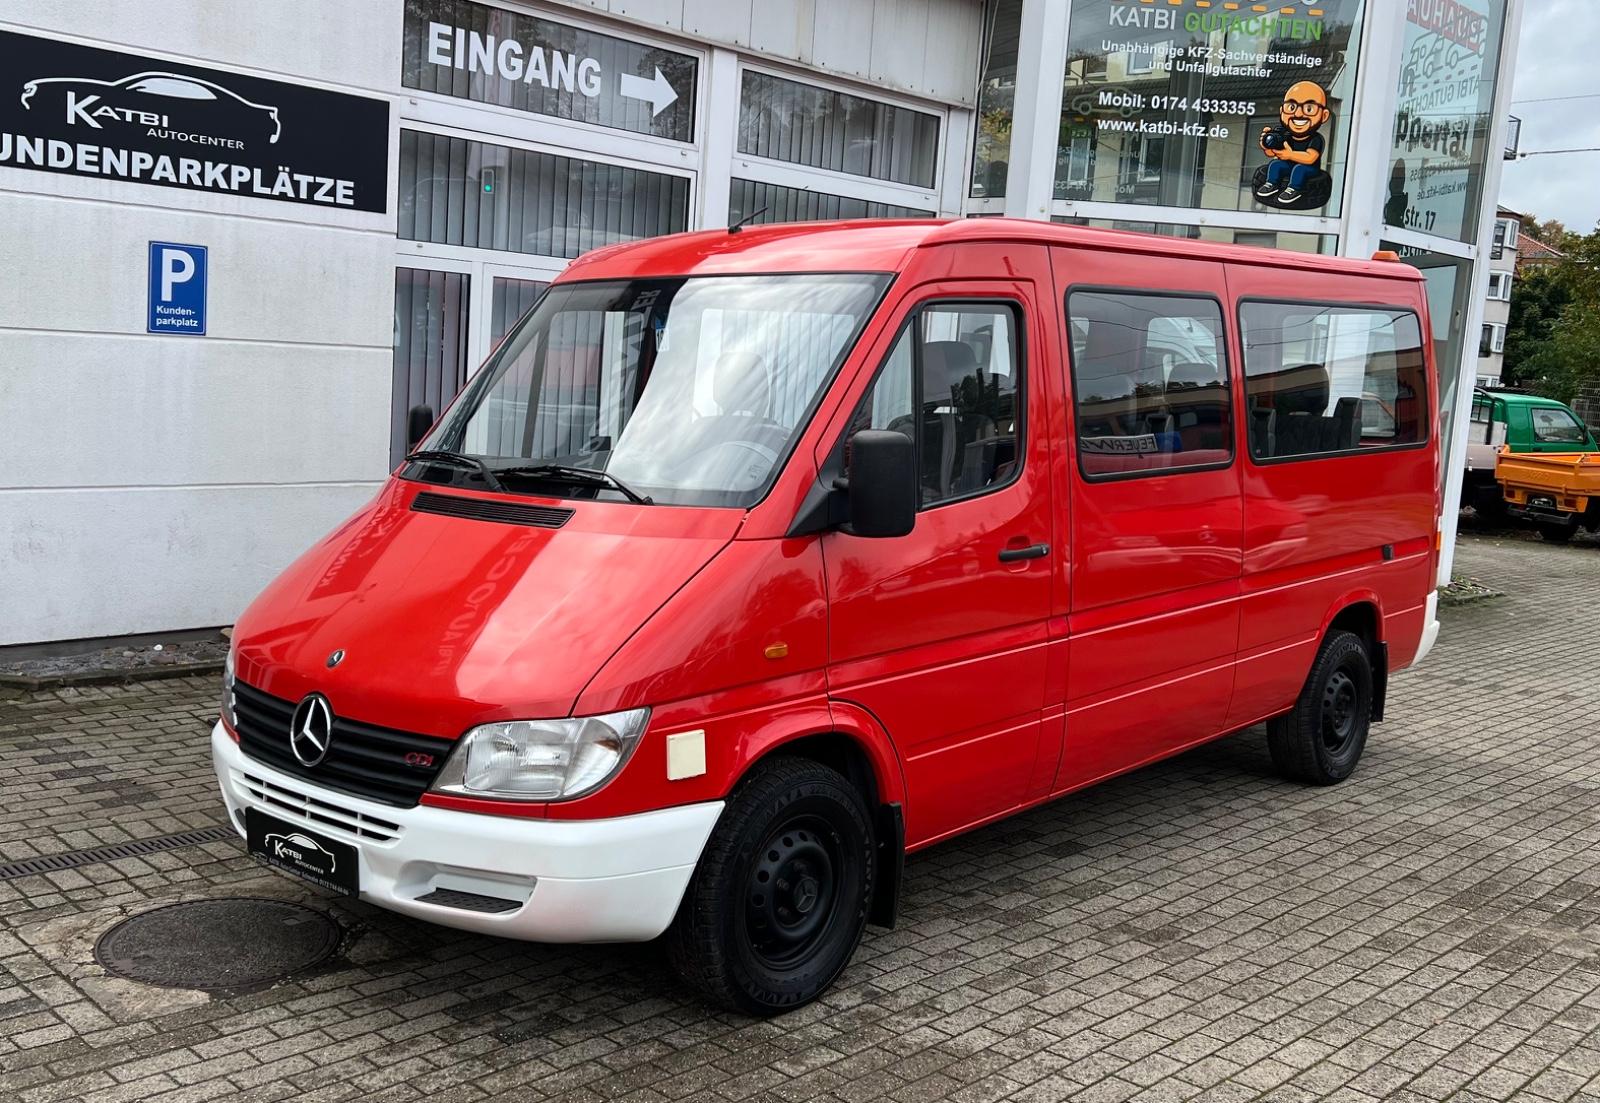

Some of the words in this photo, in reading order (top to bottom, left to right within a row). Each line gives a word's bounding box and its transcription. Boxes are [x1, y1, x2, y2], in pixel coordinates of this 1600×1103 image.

[1108, 6, 1177, 31] KATBI
[1184, 12, 1324, 41] GUTACHTEN
[428, 21, 601, 98] EINGANG
[1101, 39, 1184, 59] Unabhängige
[1187, 46, 1322, 67] KFZ-Sachverständige
[1148, 59, 1172, 71] und
[1176, 60, 1272, 79] Unfallgutachter
[66, 90, 169, 129] KATBI
[1098, 92, 1146, 109] Mobil:
[1151, 96, 1188, 111] 0174
[1191, 98, 1256, 116] 4333355
[146, 127, 245, 151] AUTOCENTER
[1097, 117, 1229, 138] www.katbi-kfz.de
[1425, 210, 1436, 231] 17
[161, 248, 195, 302] P
[156, 305, 196, 316] Kunden-
[156, 316, 199, 328] parkplatz
[275, 839, 302, 860] KATBI
